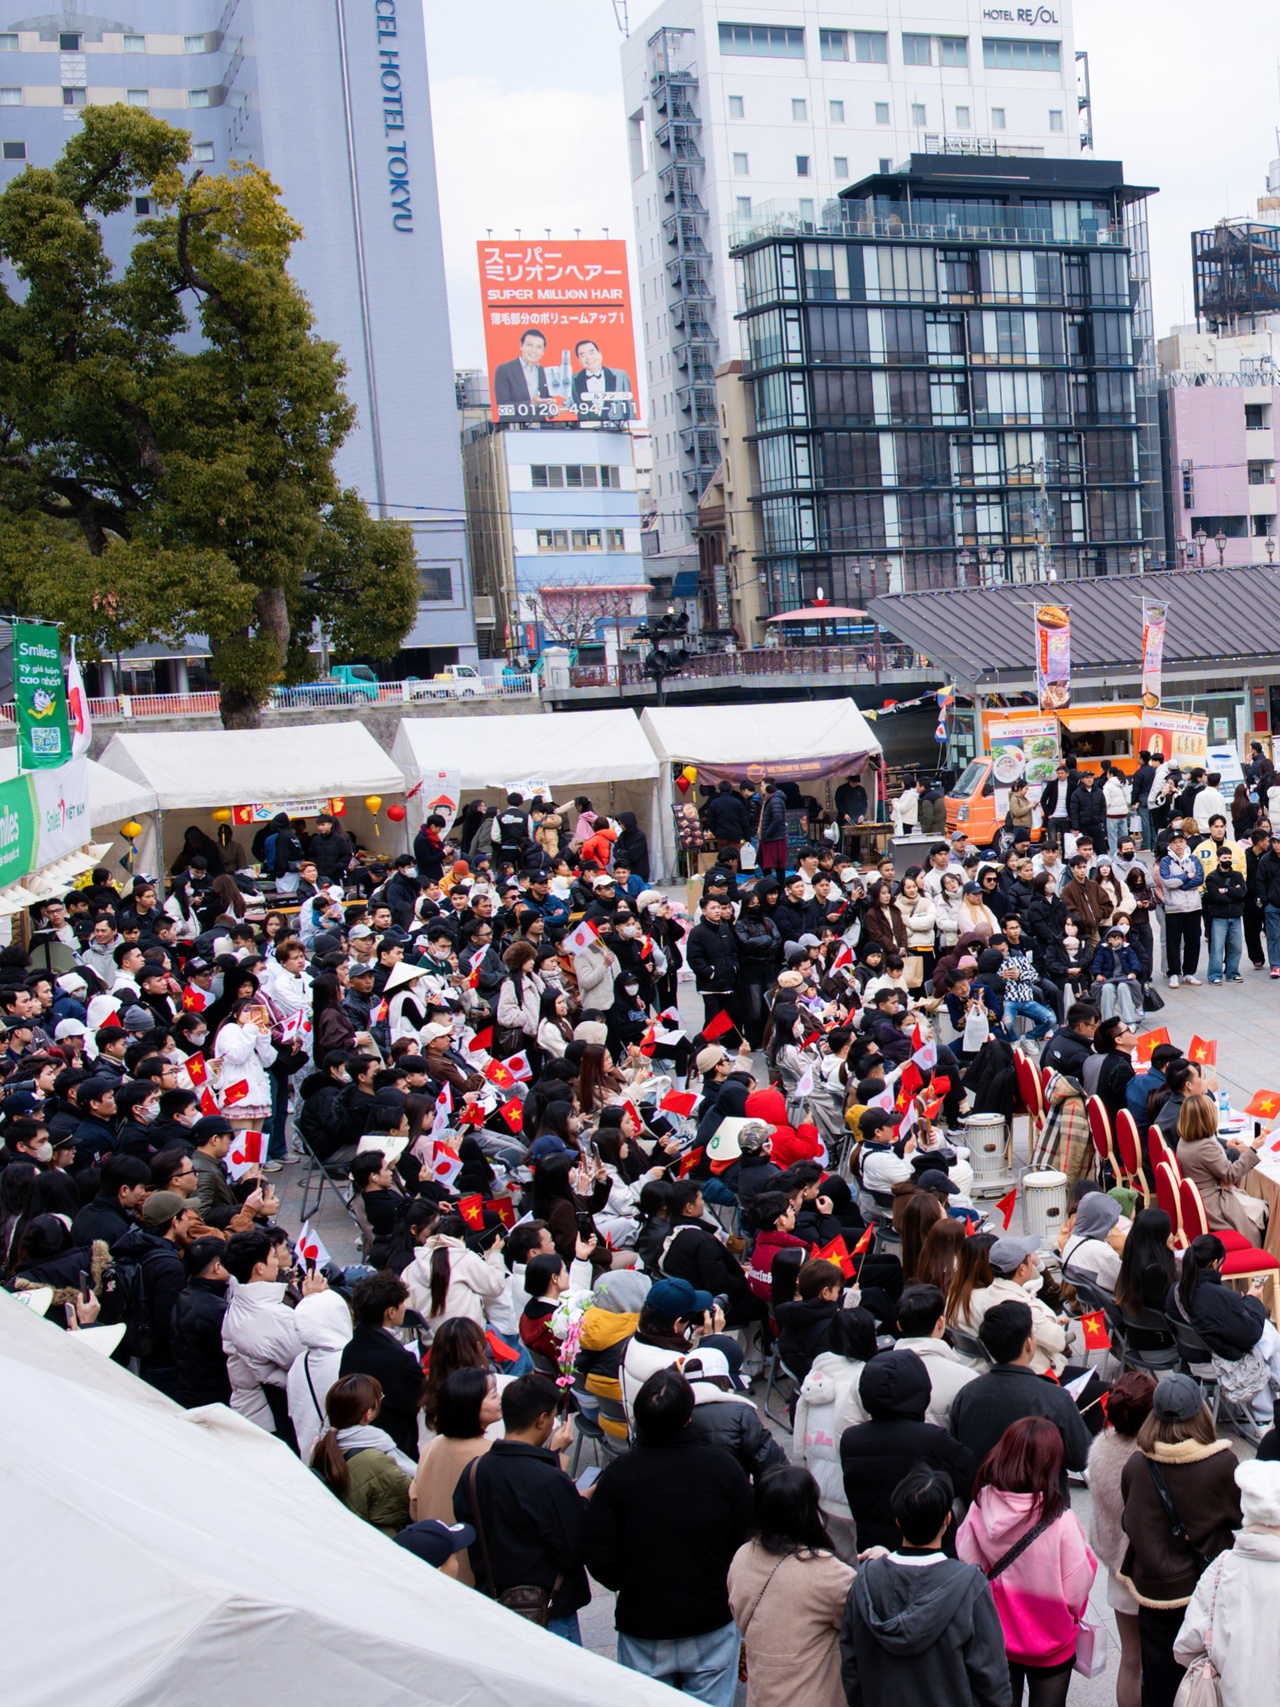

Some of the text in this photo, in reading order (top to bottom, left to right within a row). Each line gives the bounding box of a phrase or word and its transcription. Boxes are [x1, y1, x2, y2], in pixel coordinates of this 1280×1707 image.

[983, 6, 1058, 26] HOTEL RESOL
[379, 50, 405, 138] HOTEL
[387, 140, 413, 233] TOKYU
[484, 246, 562, 264] スーパー
[485, 265, 622, 281] ミリオンヘアー
[487, 289, 623, 300] SUPER MILLION HAIR
[518, 402, 638, 417] 0120-494-111
[19, 642, 57, 659] Smiles
[19, 676, 39, 685] cao
[1200, 849, 1211, 859] D
